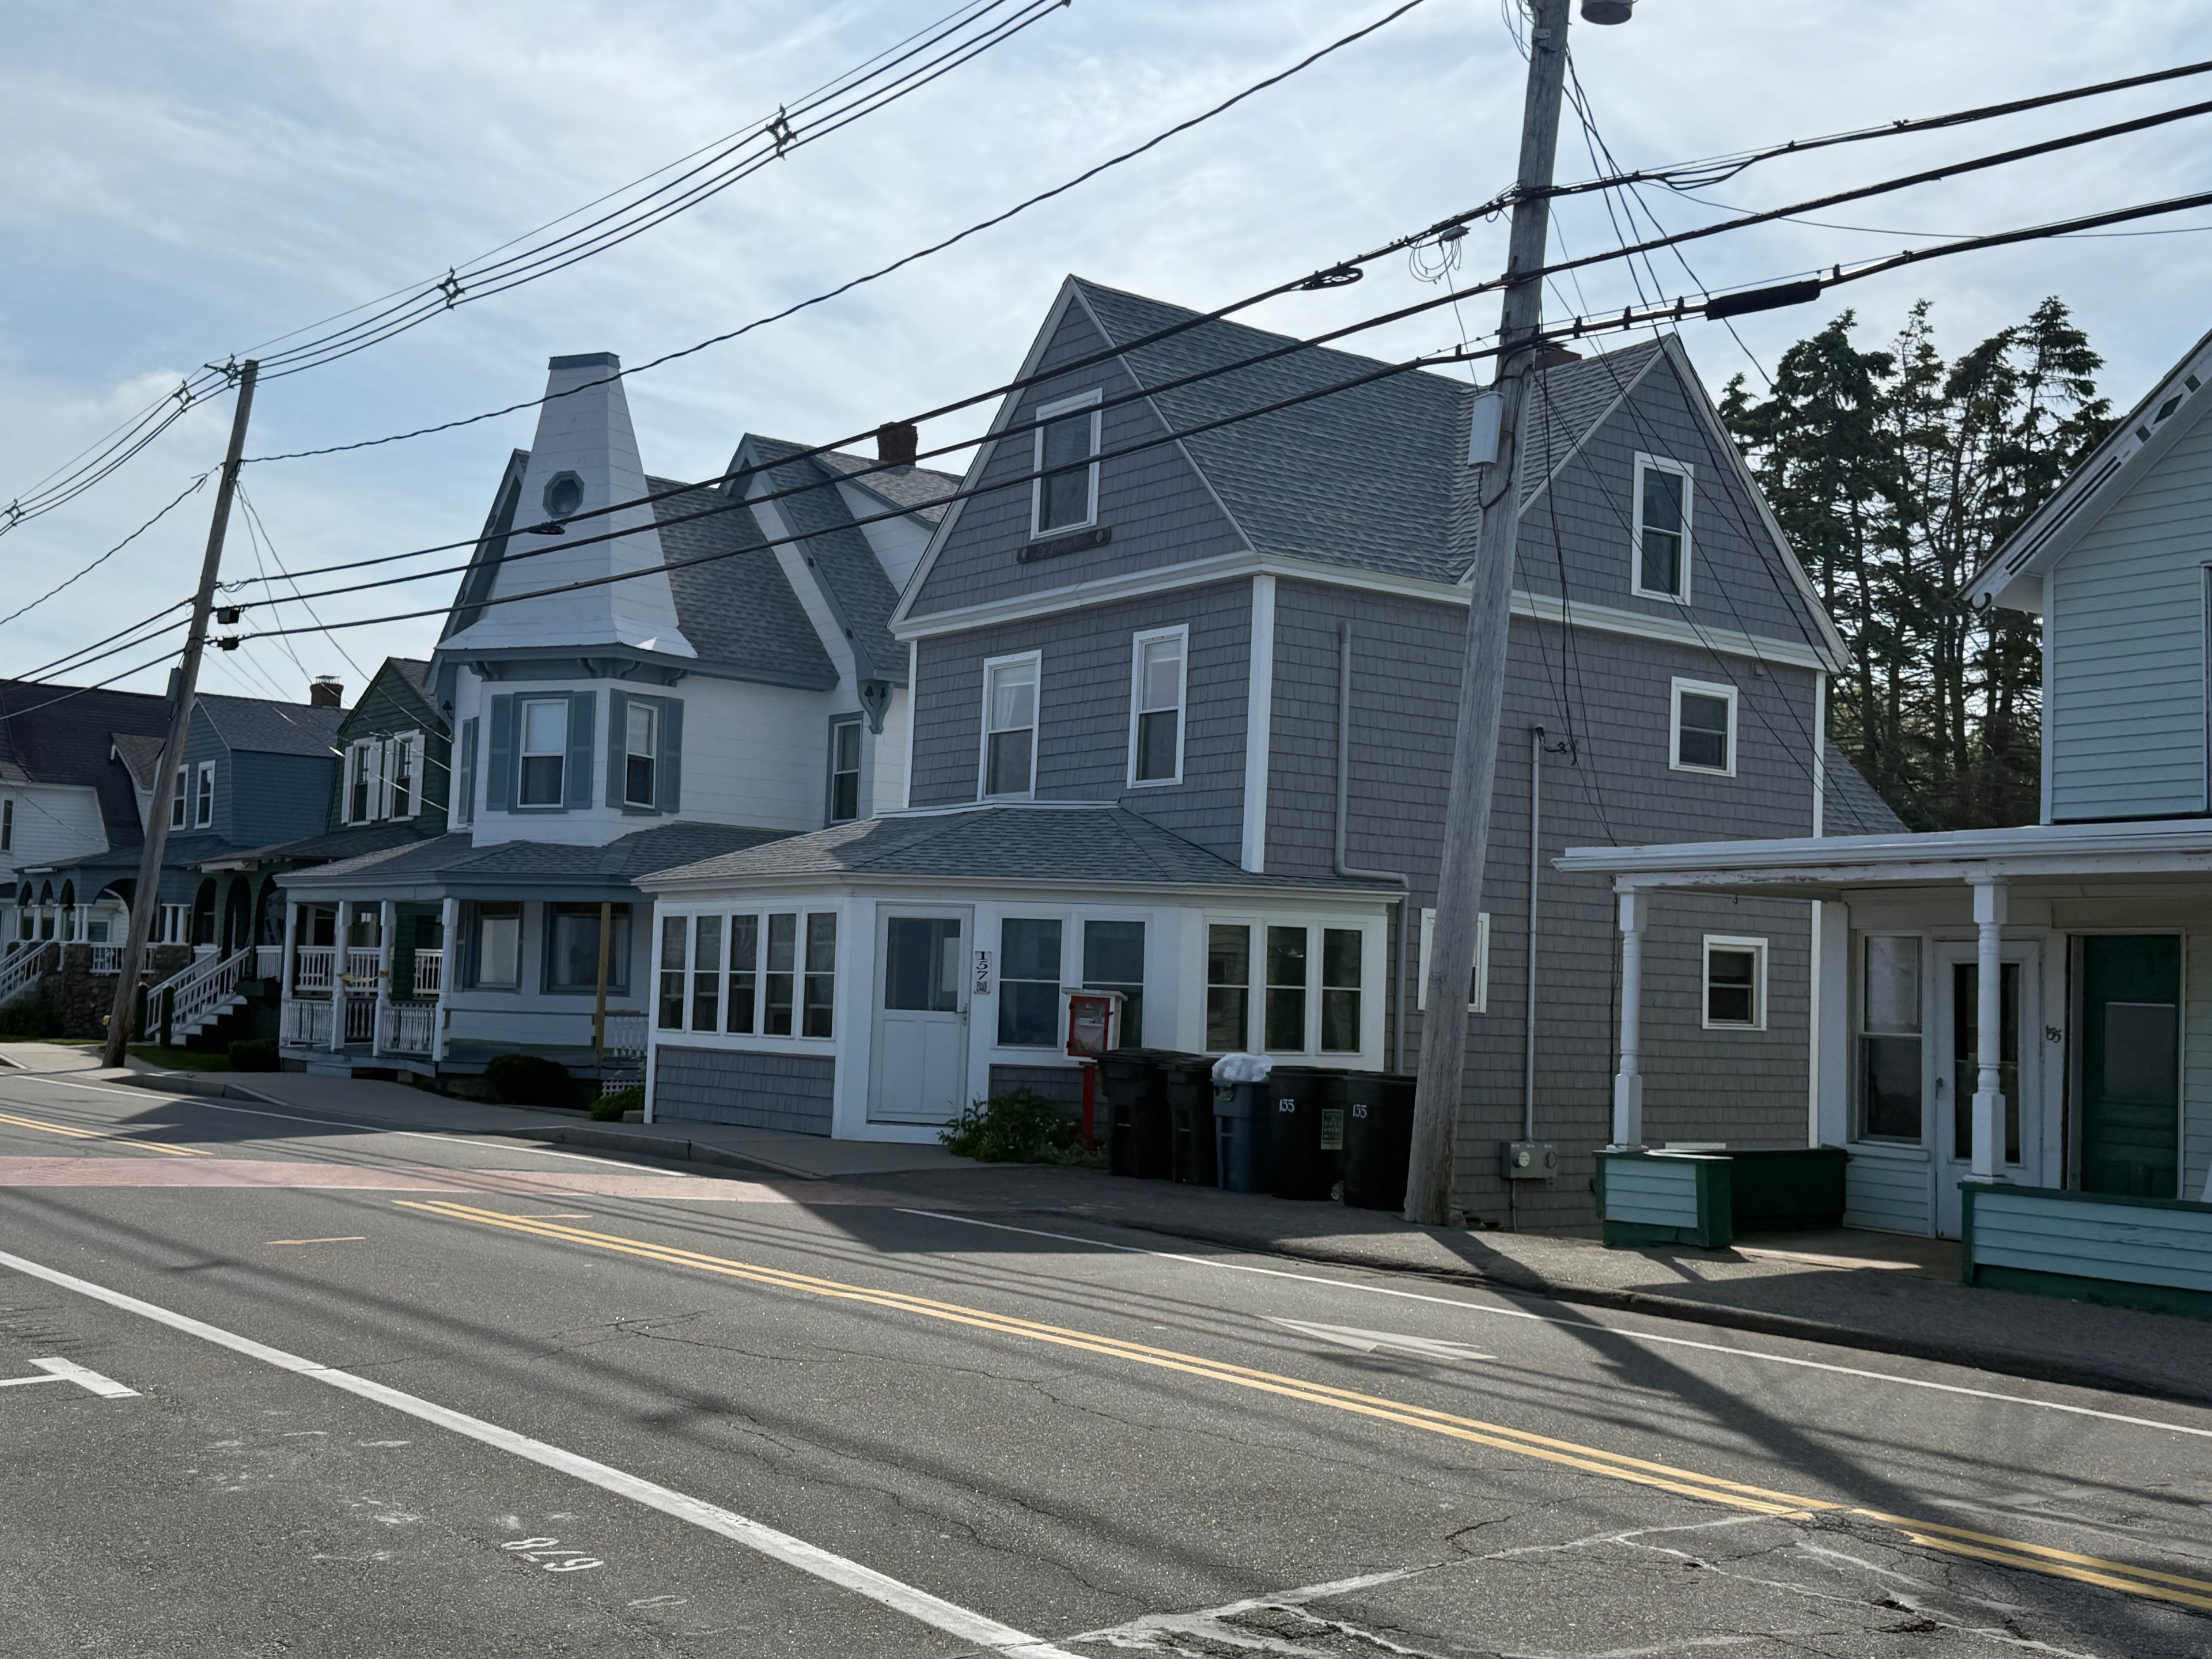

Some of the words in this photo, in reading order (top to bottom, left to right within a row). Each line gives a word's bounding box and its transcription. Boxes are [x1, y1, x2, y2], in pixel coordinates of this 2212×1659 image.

[976, 951, 989, 980] 157
[2046, 1024, 2062, 1043] 155
[1279, 1099, 1295, 1112] 155
[1353, 1104, 1368, 1119] 155
